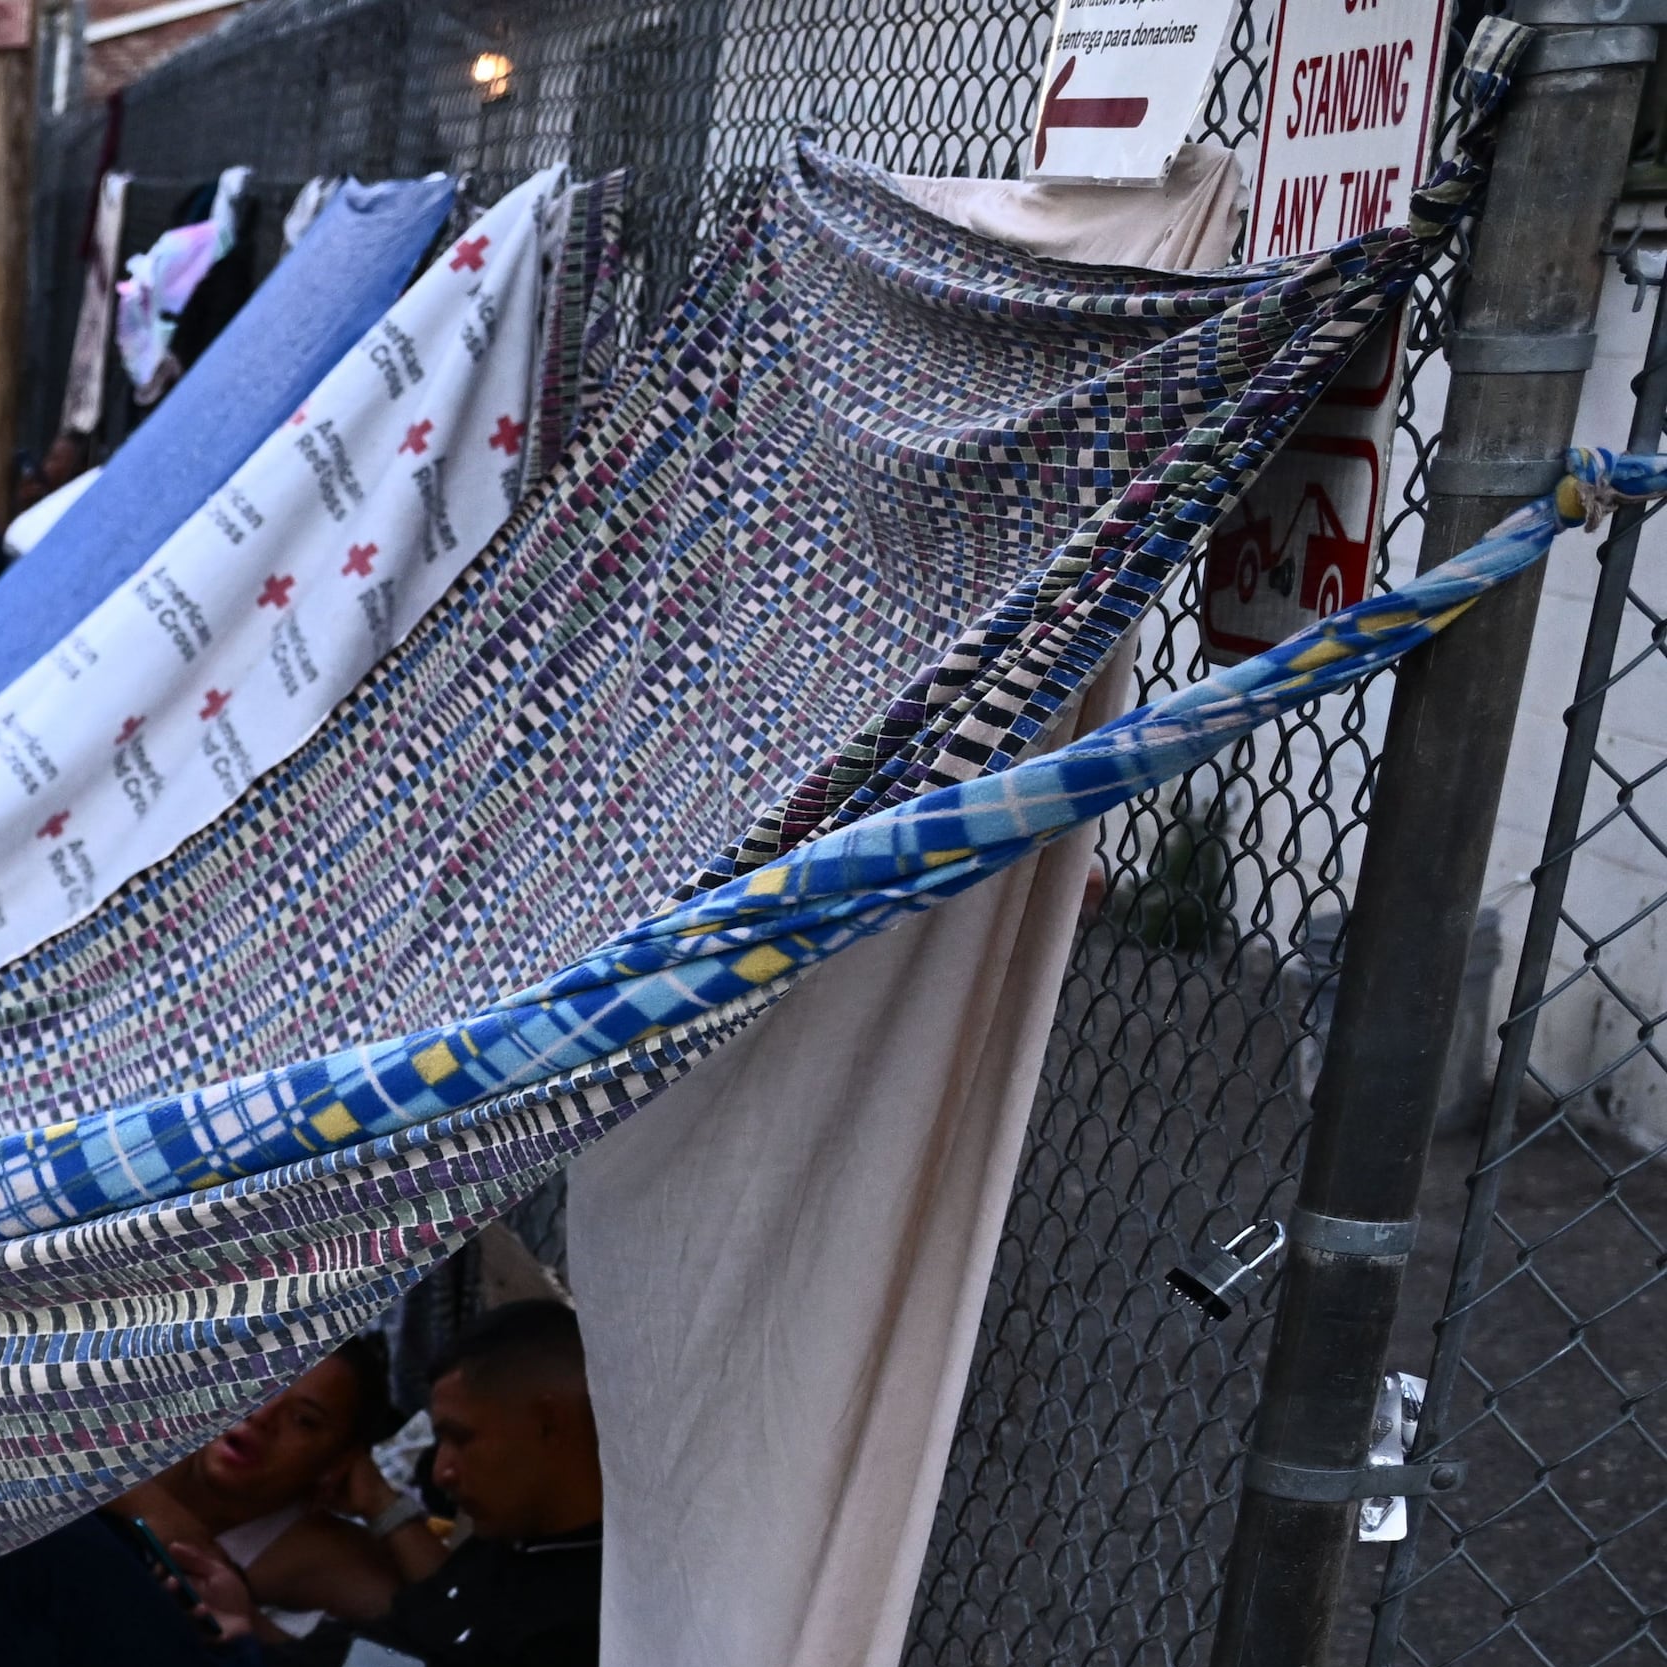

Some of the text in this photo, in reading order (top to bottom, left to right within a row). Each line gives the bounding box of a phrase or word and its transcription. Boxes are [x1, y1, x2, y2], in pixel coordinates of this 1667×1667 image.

[1063, 29, 1103, 54] entrega
[1100, 28, 1131, 54] para
[1131, 19, 1198, 46] donaciones
[1286, 39, 1413, 139] STANDING
[1267, 167, 1400, 256] ANY TIME
